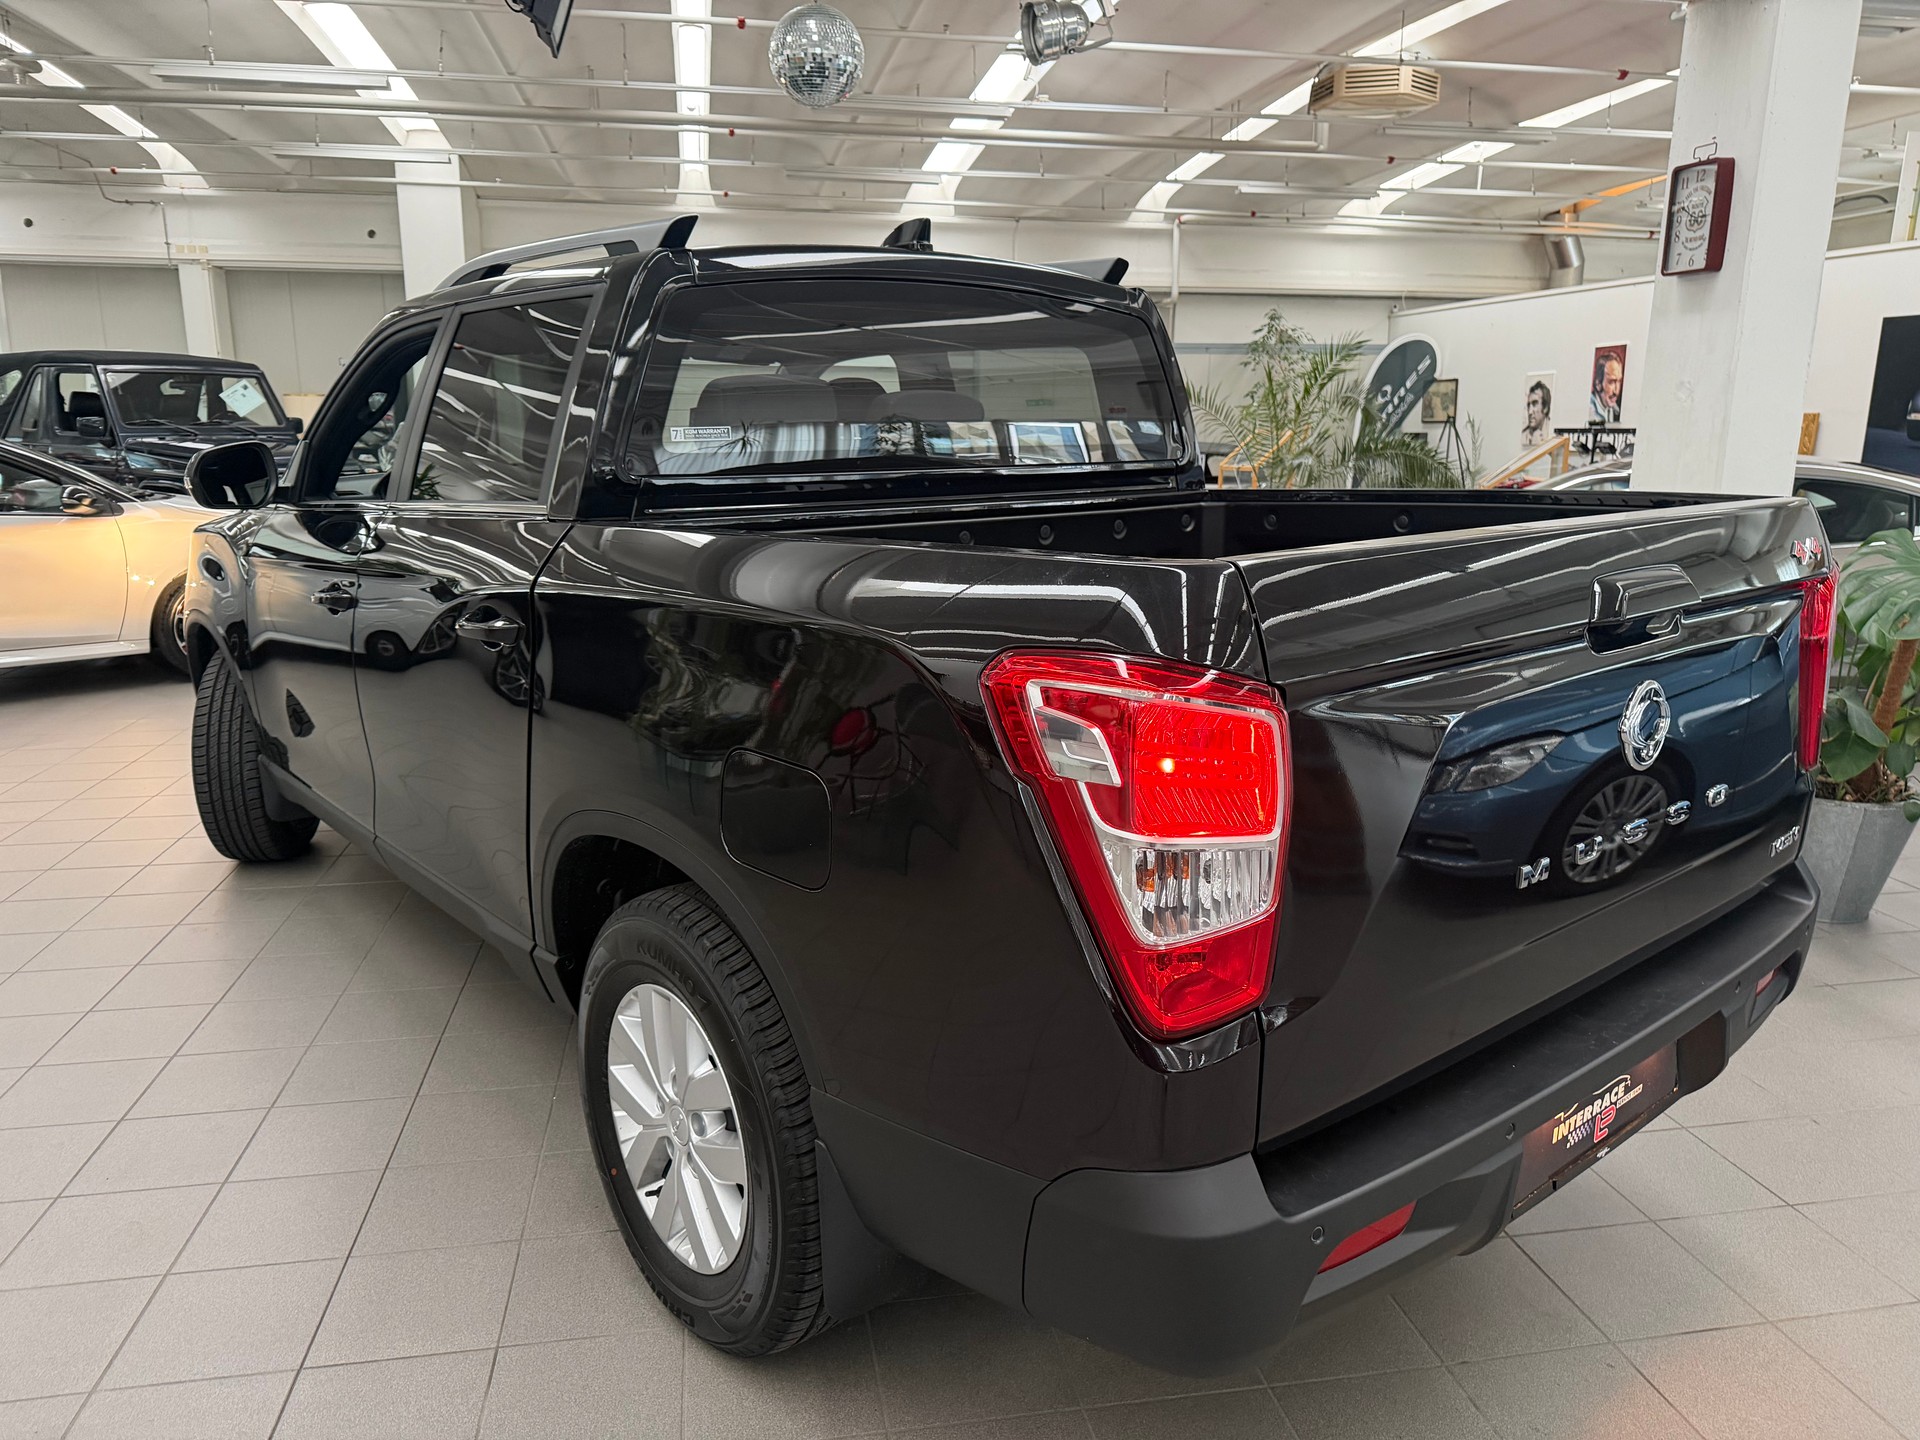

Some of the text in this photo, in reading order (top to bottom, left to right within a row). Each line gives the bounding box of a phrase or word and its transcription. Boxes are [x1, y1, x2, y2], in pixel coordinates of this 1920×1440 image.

[1696, 169, 1706, 183] 12
[1681, 177, 1689, 190] 11
[1676, 215, 1682, 228] 9
[1674, 231, 1681, 243] 8
[1675, 253, 1682, 266] 7
[1688, 253, 1695, 267] 6
[671, 429, 679, 440] 7
[1516, 783, 1729, 889] MUSSO
[637, 938, 696, 996] KUMHO
[1552, 1081, 1626, 1145] INTERRACE
